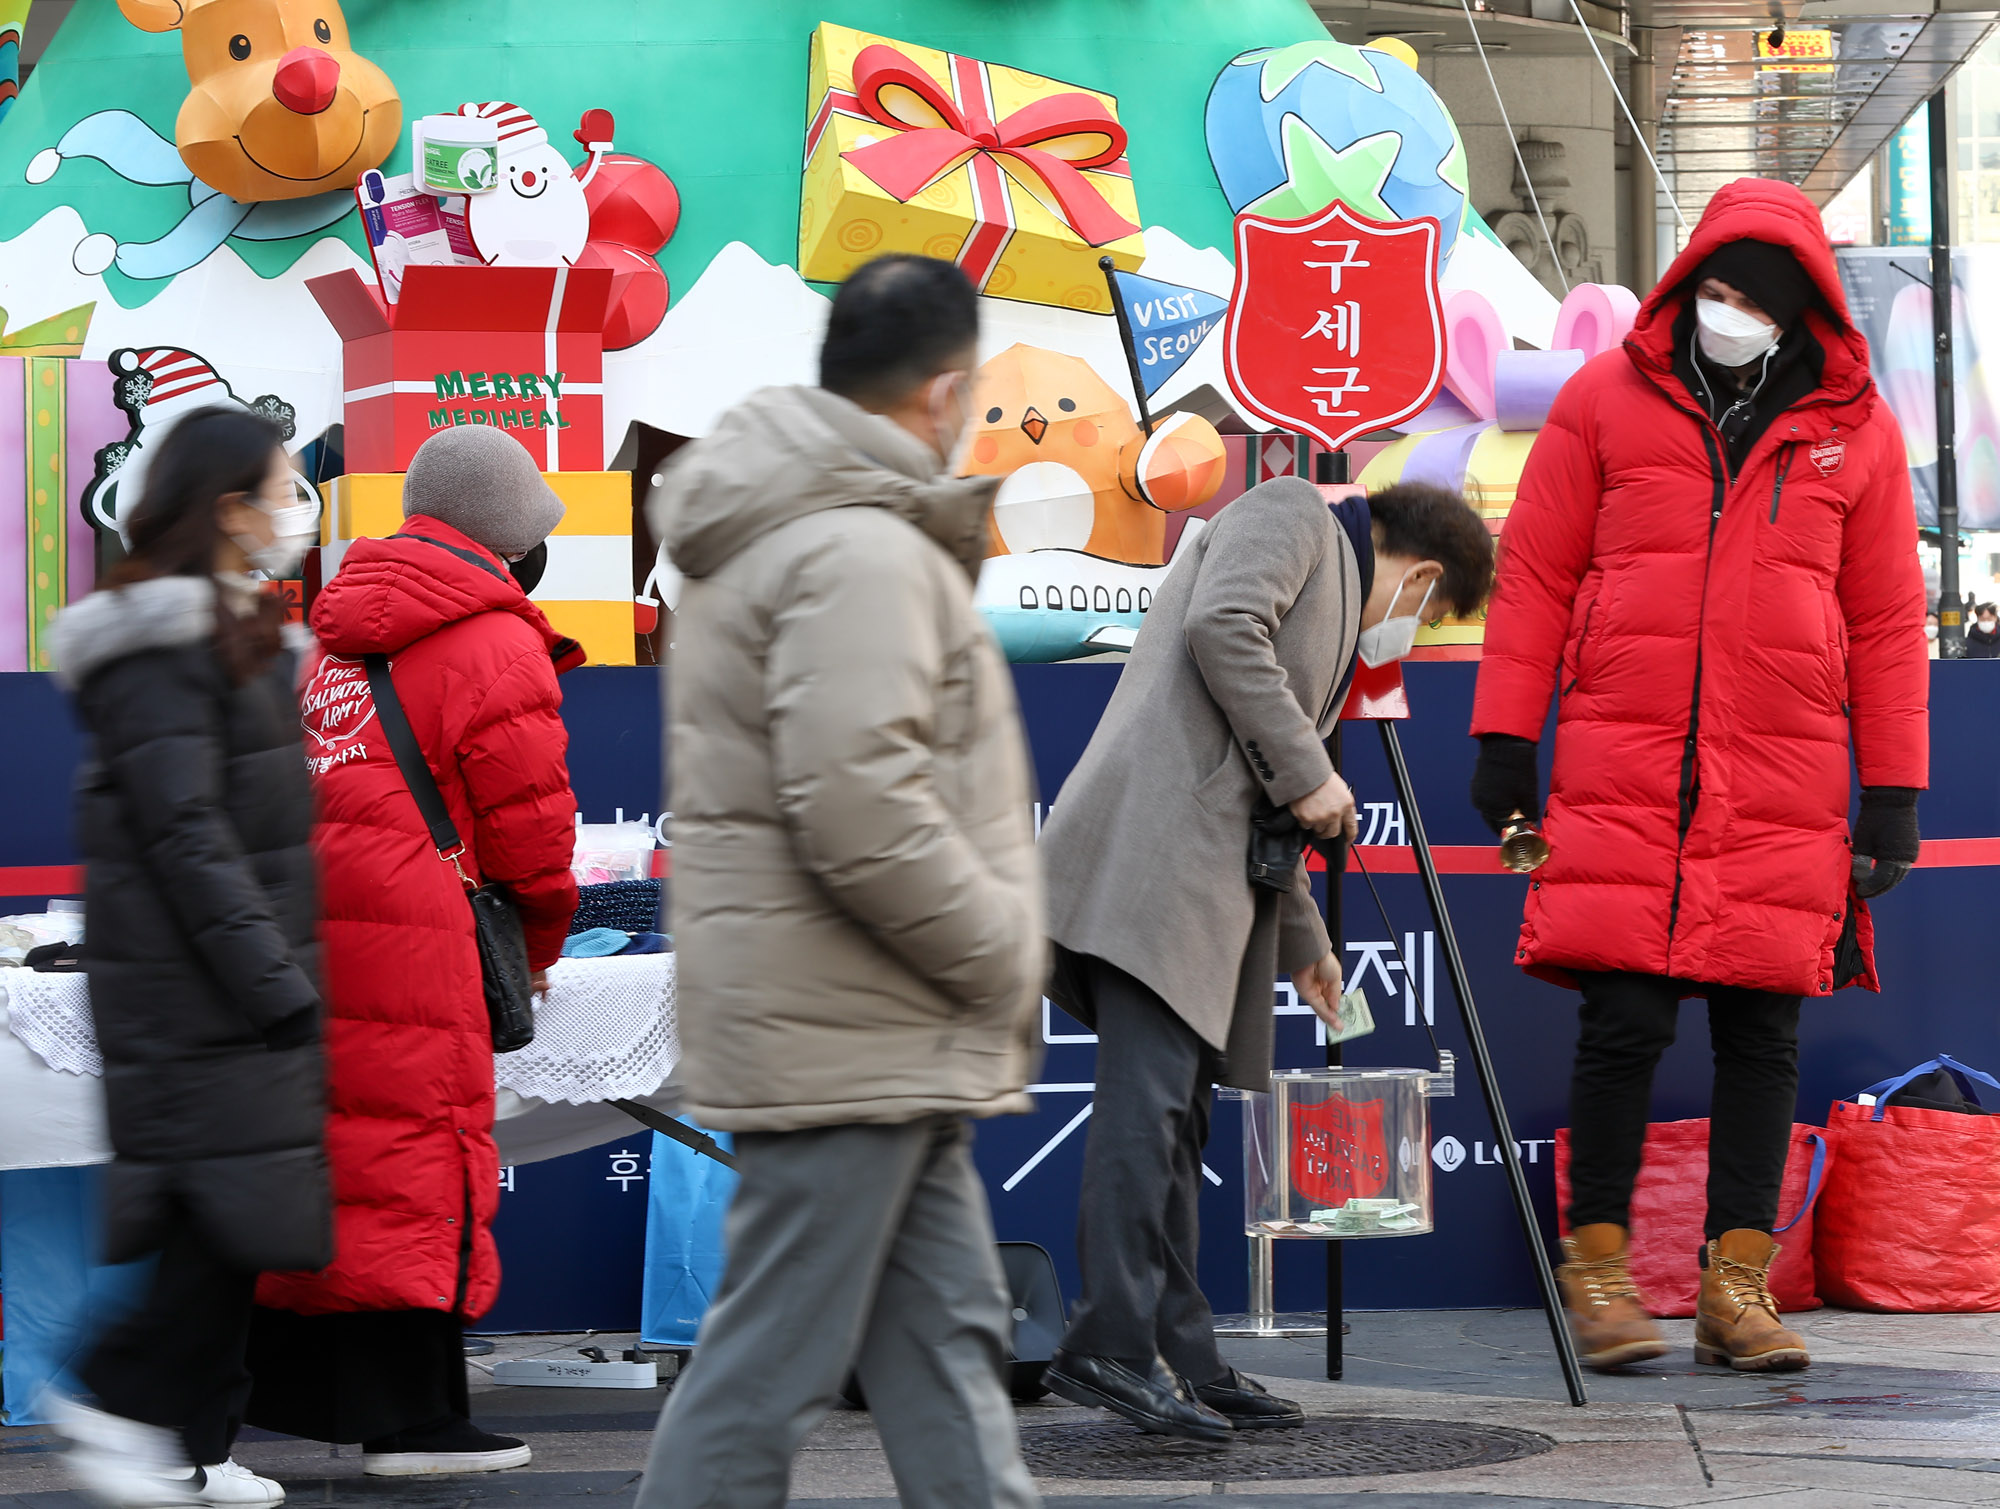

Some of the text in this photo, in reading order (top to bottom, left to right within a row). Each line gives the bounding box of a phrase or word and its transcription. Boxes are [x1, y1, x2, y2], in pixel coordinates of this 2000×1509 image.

[390, 201, 415, 213] TENSION
[1133, 292, 1199, 328] VISIT
[1300, 239, 1371, 417] 구세군
[1142, 320, 1213, 366] SEOUL
[434, 370, 566, 402] MERRY
[427, 408, 571, 430] MEDIHEAL
[322, 667, 362, 686] THE
[303, 680, 372, 716] SALVATIO
[320, 694, 368, 731] ARMY
[304, 742, 367, 775] 비봉사자
[606, 1149, 652, 1192] 후
